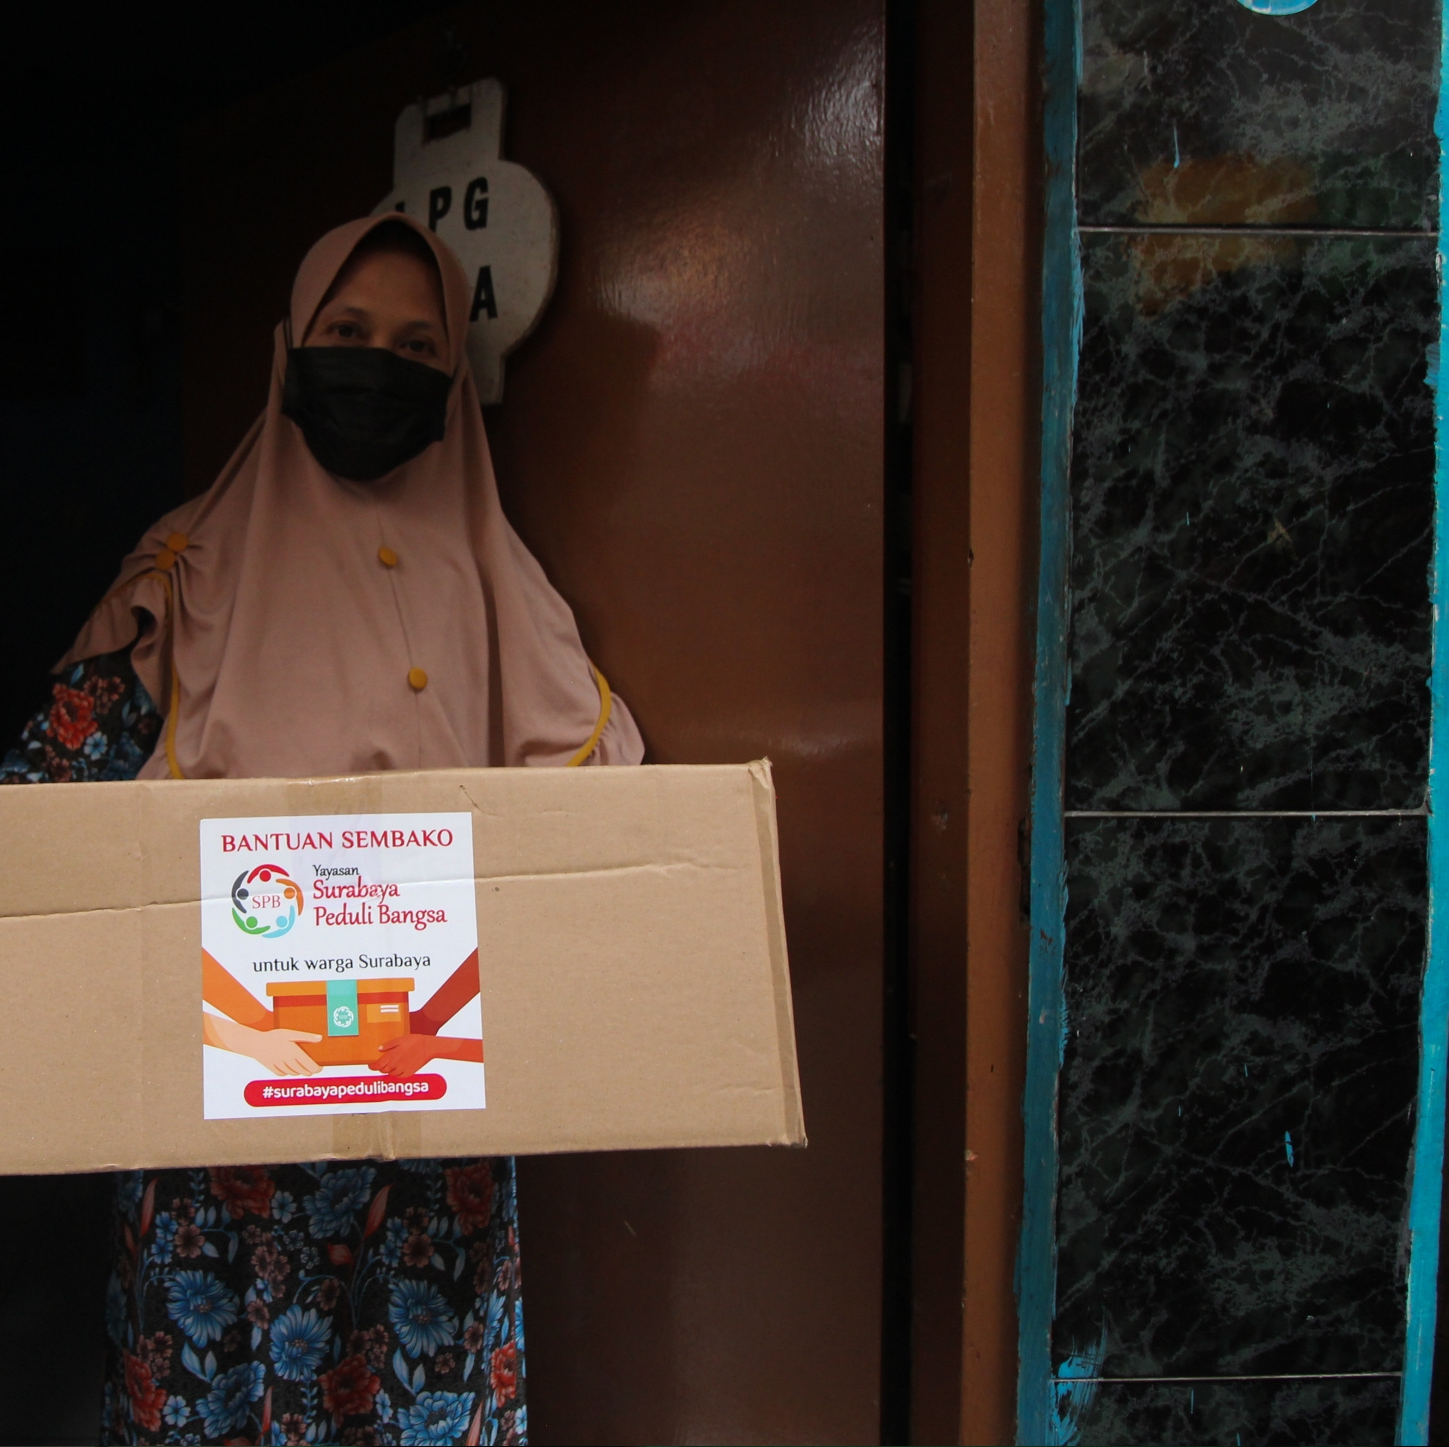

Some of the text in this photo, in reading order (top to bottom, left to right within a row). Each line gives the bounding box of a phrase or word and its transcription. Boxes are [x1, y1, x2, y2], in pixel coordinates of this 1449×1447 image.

[221, 829, 453, 852] BANTUAN SEMBAKO
[313, 864, 359, 879] Yayasan
[313, 876, 400, 904] Surabaya
[252, 895, 281, 908] SPB
[314, 903, 448, 930] Peduli Bangsa
[253, 954, 431, 972] untuk warga Surabaya
[262, 1081, 429, 1099] #surabayapedulibangsa
